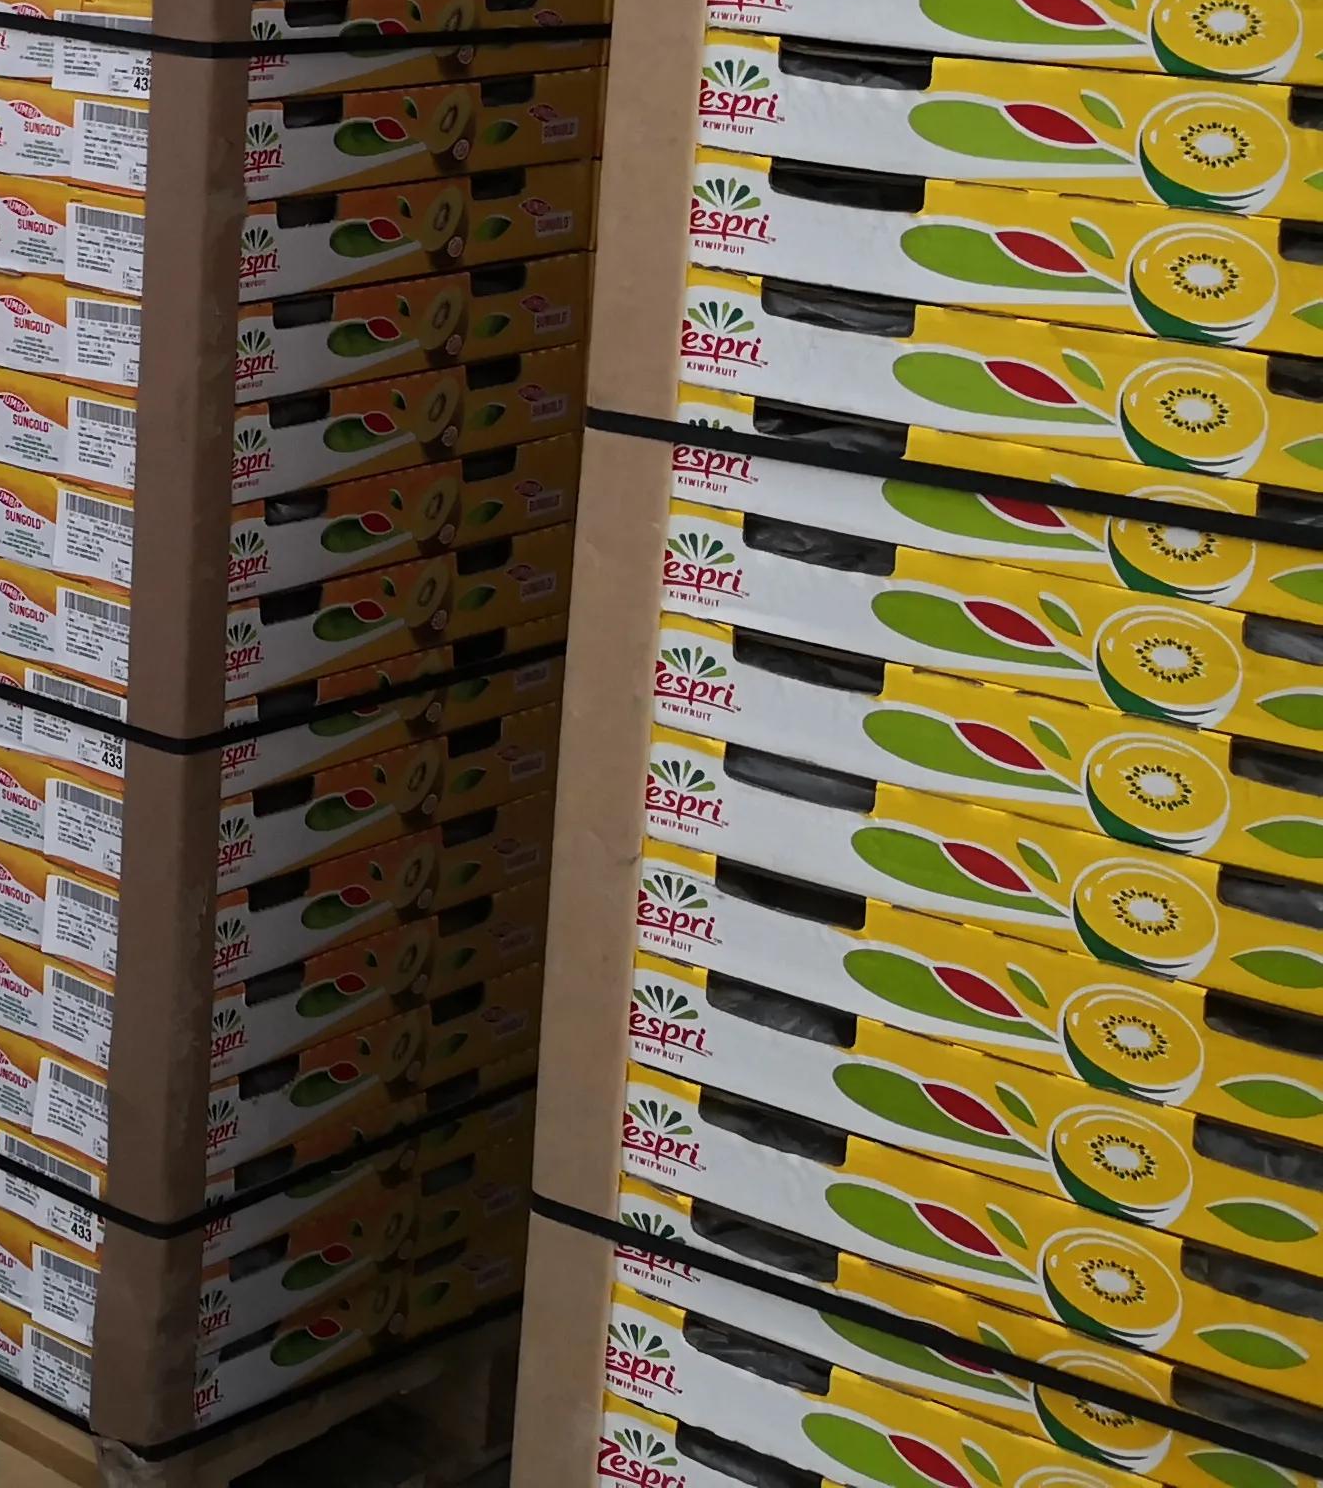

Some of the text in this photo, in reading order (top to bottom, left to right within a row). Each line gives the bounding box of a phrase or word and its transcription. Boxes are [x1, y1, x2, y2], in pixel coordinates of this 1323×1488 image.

[710, 12, 762, 24] KIWIFRUIT
[702, 120, 754, 135] KIWIFRUIT
[17, 219, 54, 235] SUNGOLD
[694, 240, 745, 255] KIWIFRUIT
[5, 510, 41, 529] SUNGOLD
[669, 591, 720, 608] KIWIFRUIT
[2, 791, 38, 809] SUNGOLD
[650, 815, 700, 835] KIWIFRUIT
[643, 931, 693, 953] KIWIFRUIT
[629, 1154, 676, 1177] KIWIFRUIT
[71, 1224, 91, 1242] 433
